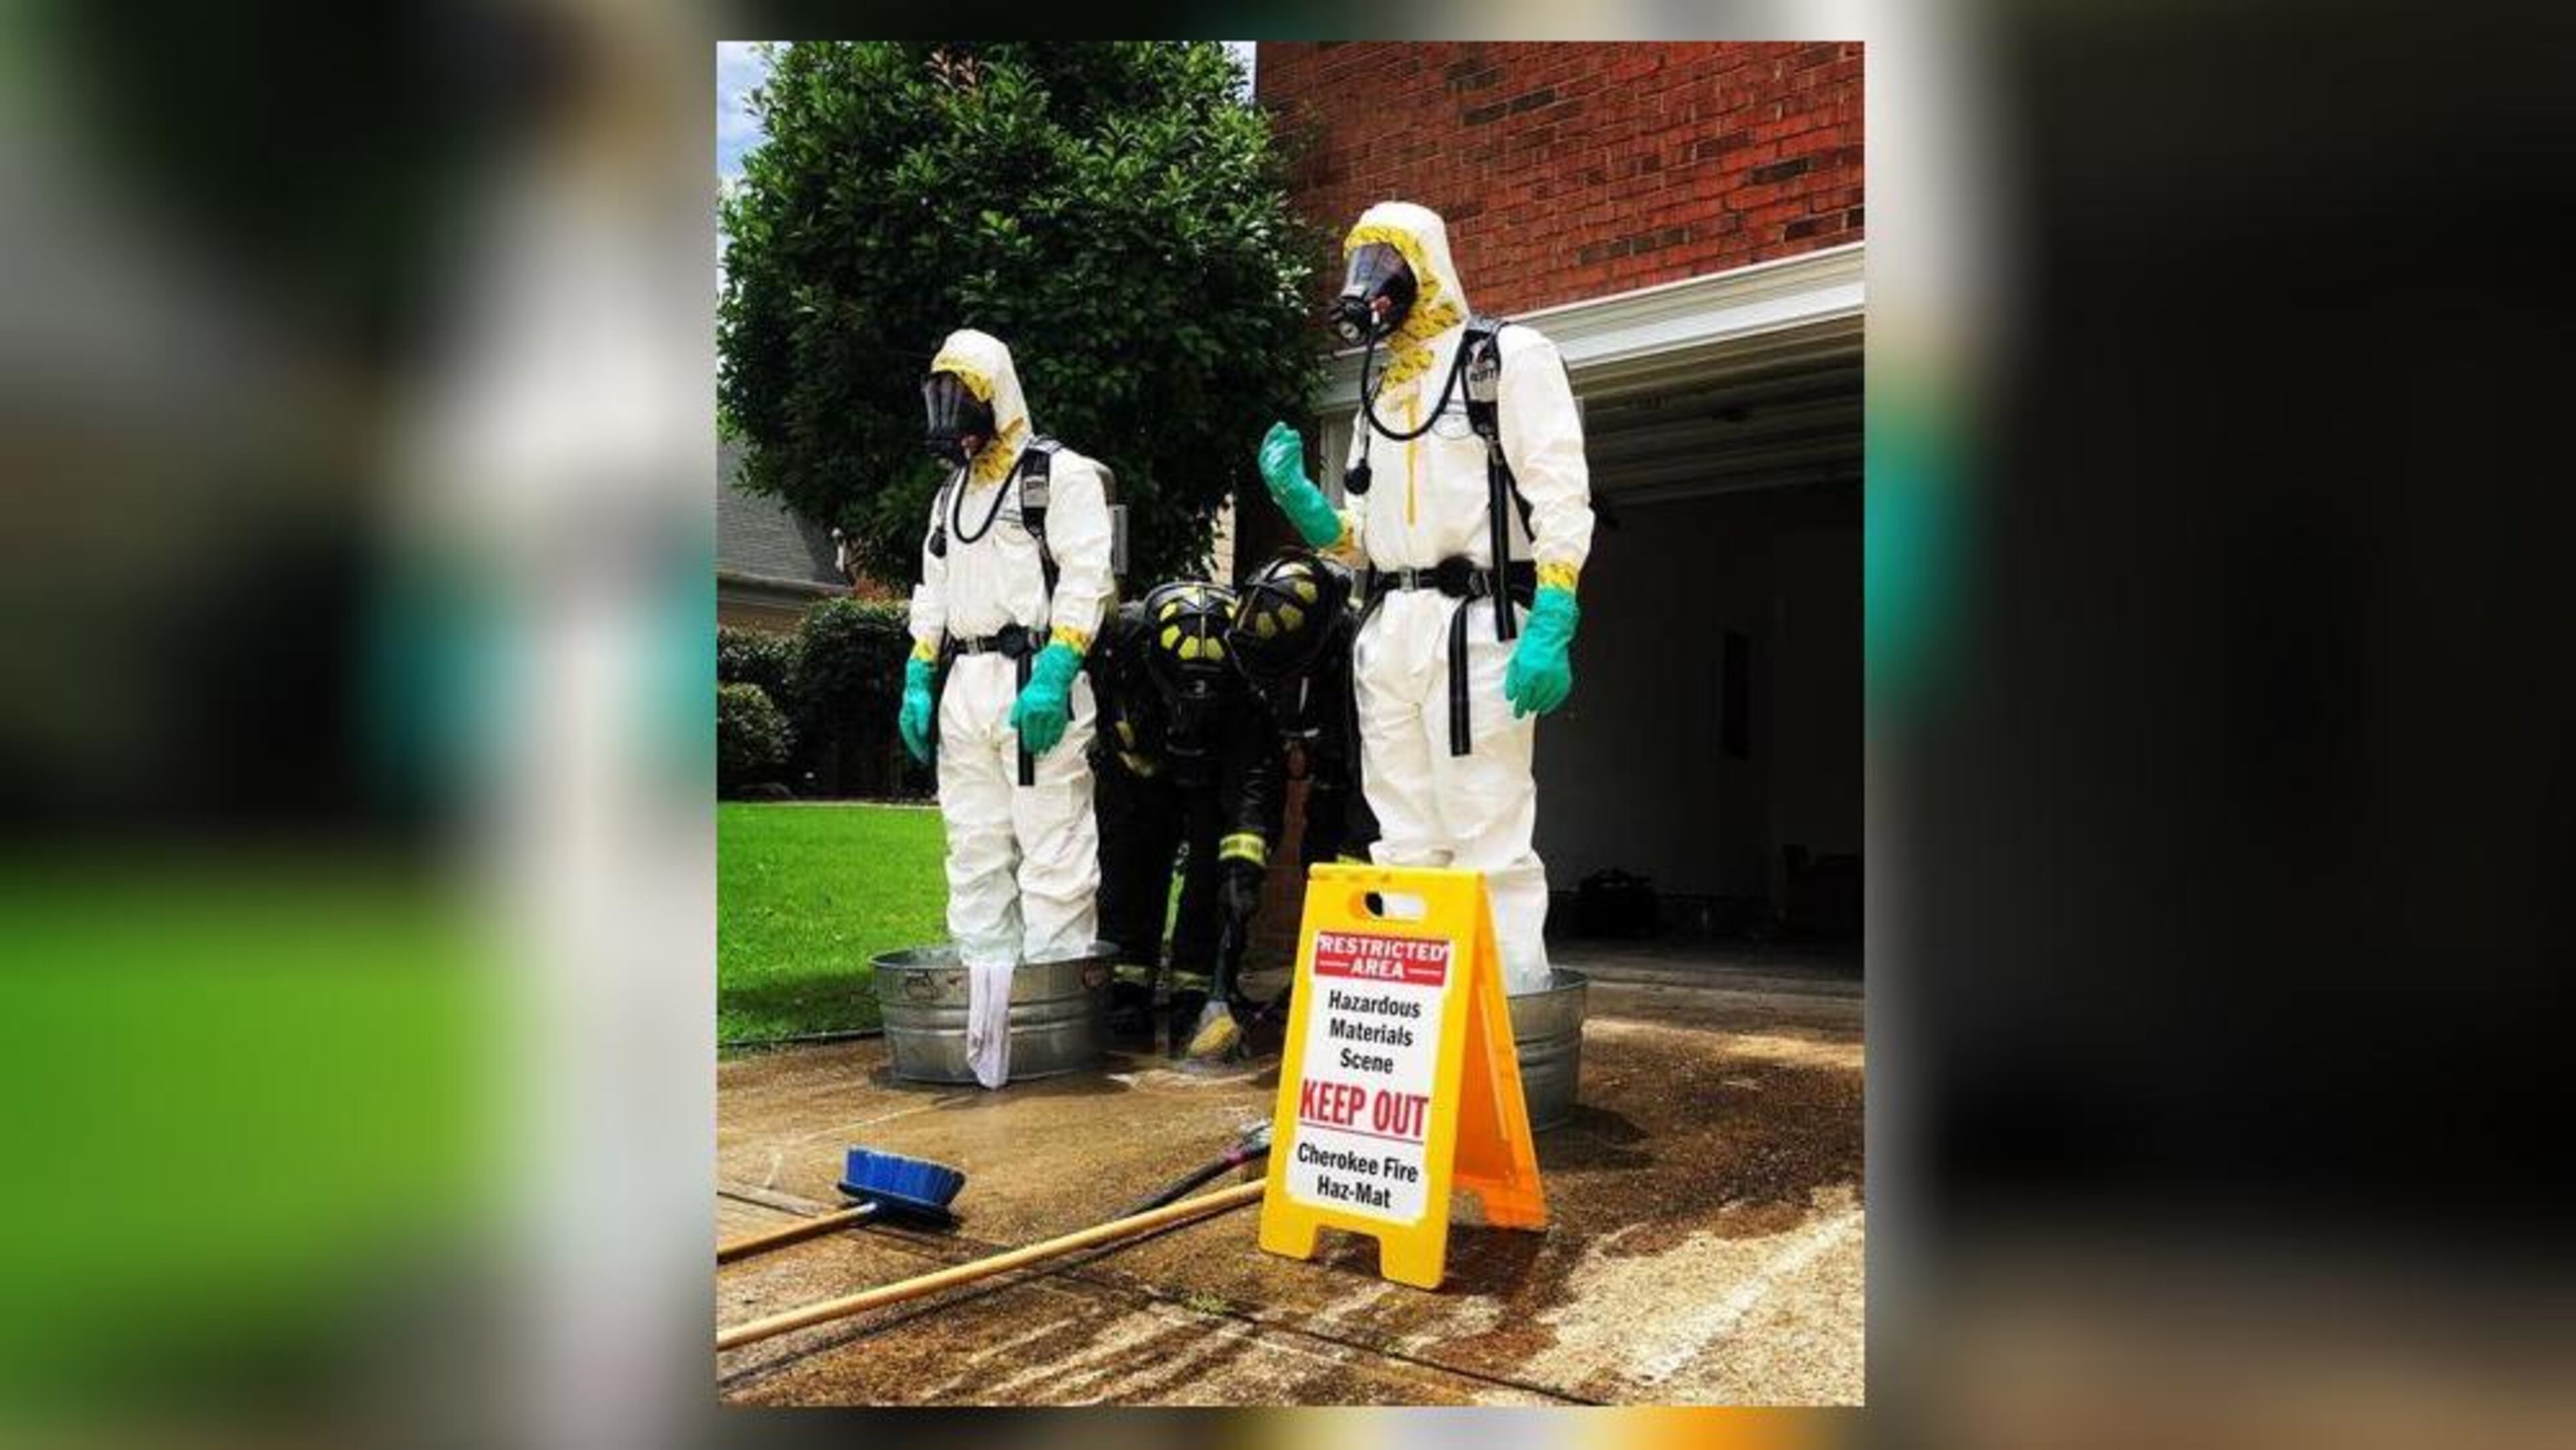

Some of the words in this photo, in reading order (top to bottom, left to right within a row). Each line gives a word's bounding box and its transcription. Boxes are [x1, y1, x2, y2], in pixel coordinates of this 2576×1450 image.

[1320, 934, 1444, 959] RESTRICTED
[1350, 957, 1405, 977] AREA
[1328, 989, 1421, 1018] Hazardous
[1329, 1018, 1413, 1046] Materials
[1340, 1048, 1393, 1074] Scene
[1299, 1078, 1366, 1125] KEEP
[1373, 1089, 1430, 1137] OUT
[1297, 1141, 1377, 1175] Cherokee
[1383, 1157, 1419, 1183] Fire
[1317, 1176, 1391, 1209] Haz-Mat
